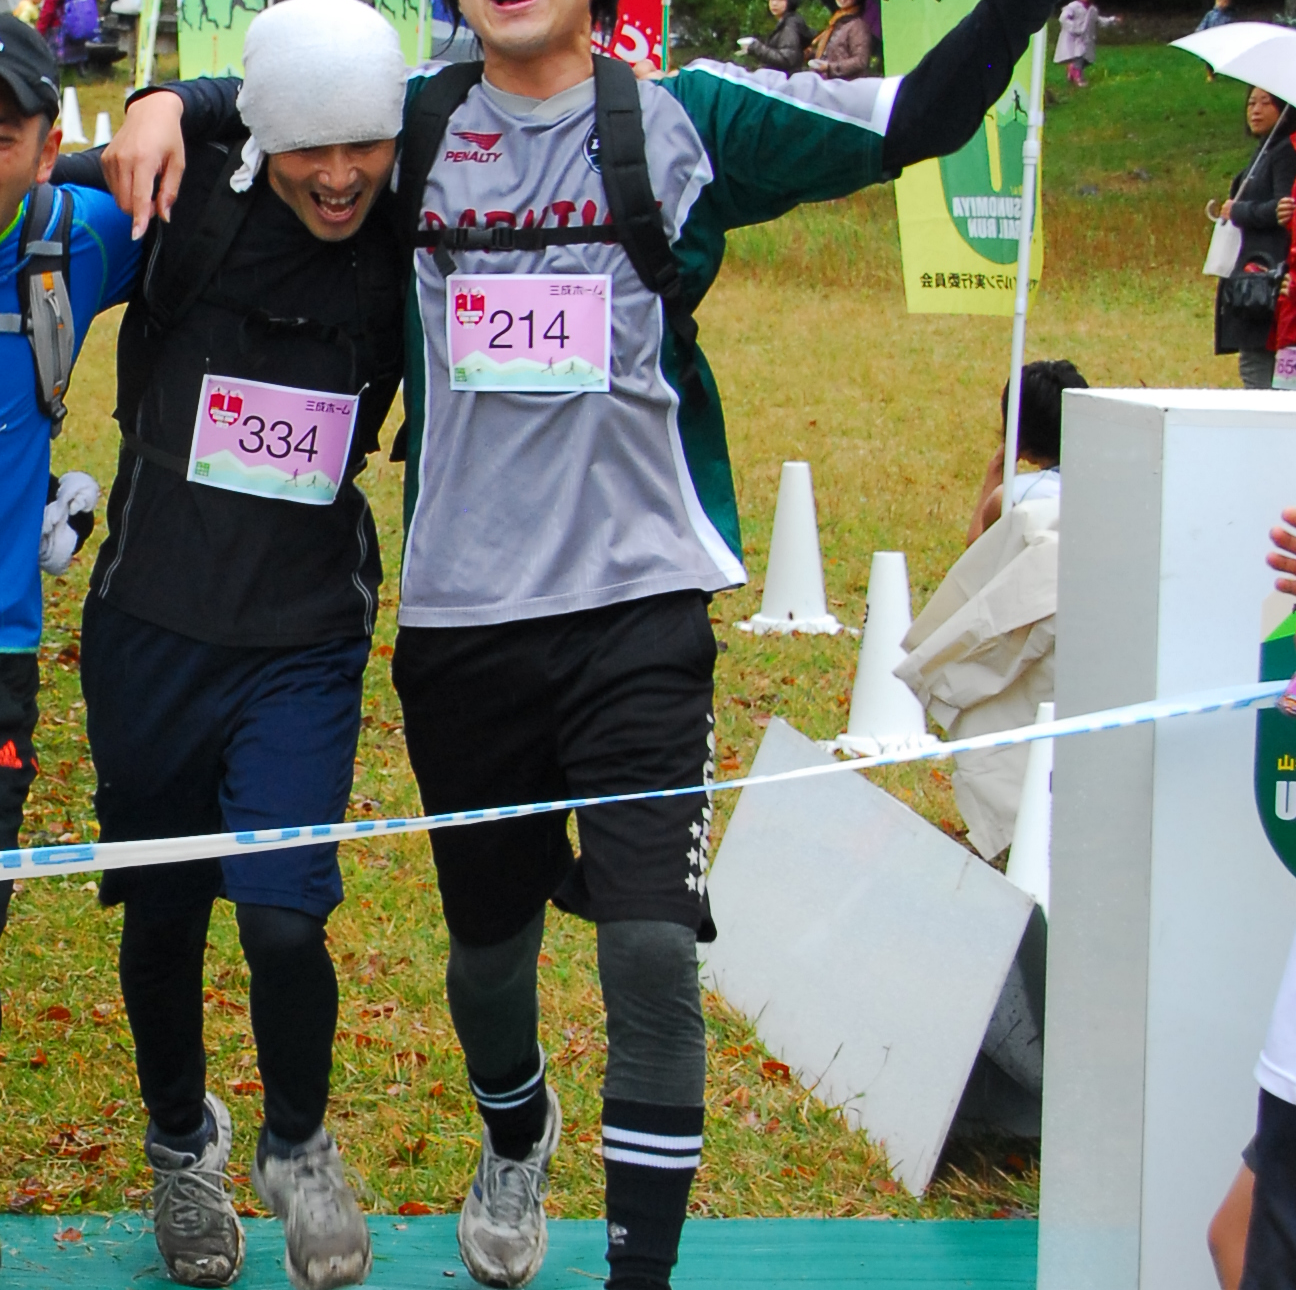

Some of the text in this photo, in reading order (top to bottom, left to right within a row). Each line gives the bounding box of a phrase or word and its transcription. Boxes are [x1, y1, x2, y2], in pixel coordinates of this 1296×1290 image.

[444, 150, 503, 163] PENALTY
[488, 309, 570, 349] 214
[238, 415, 318, 463] 334
